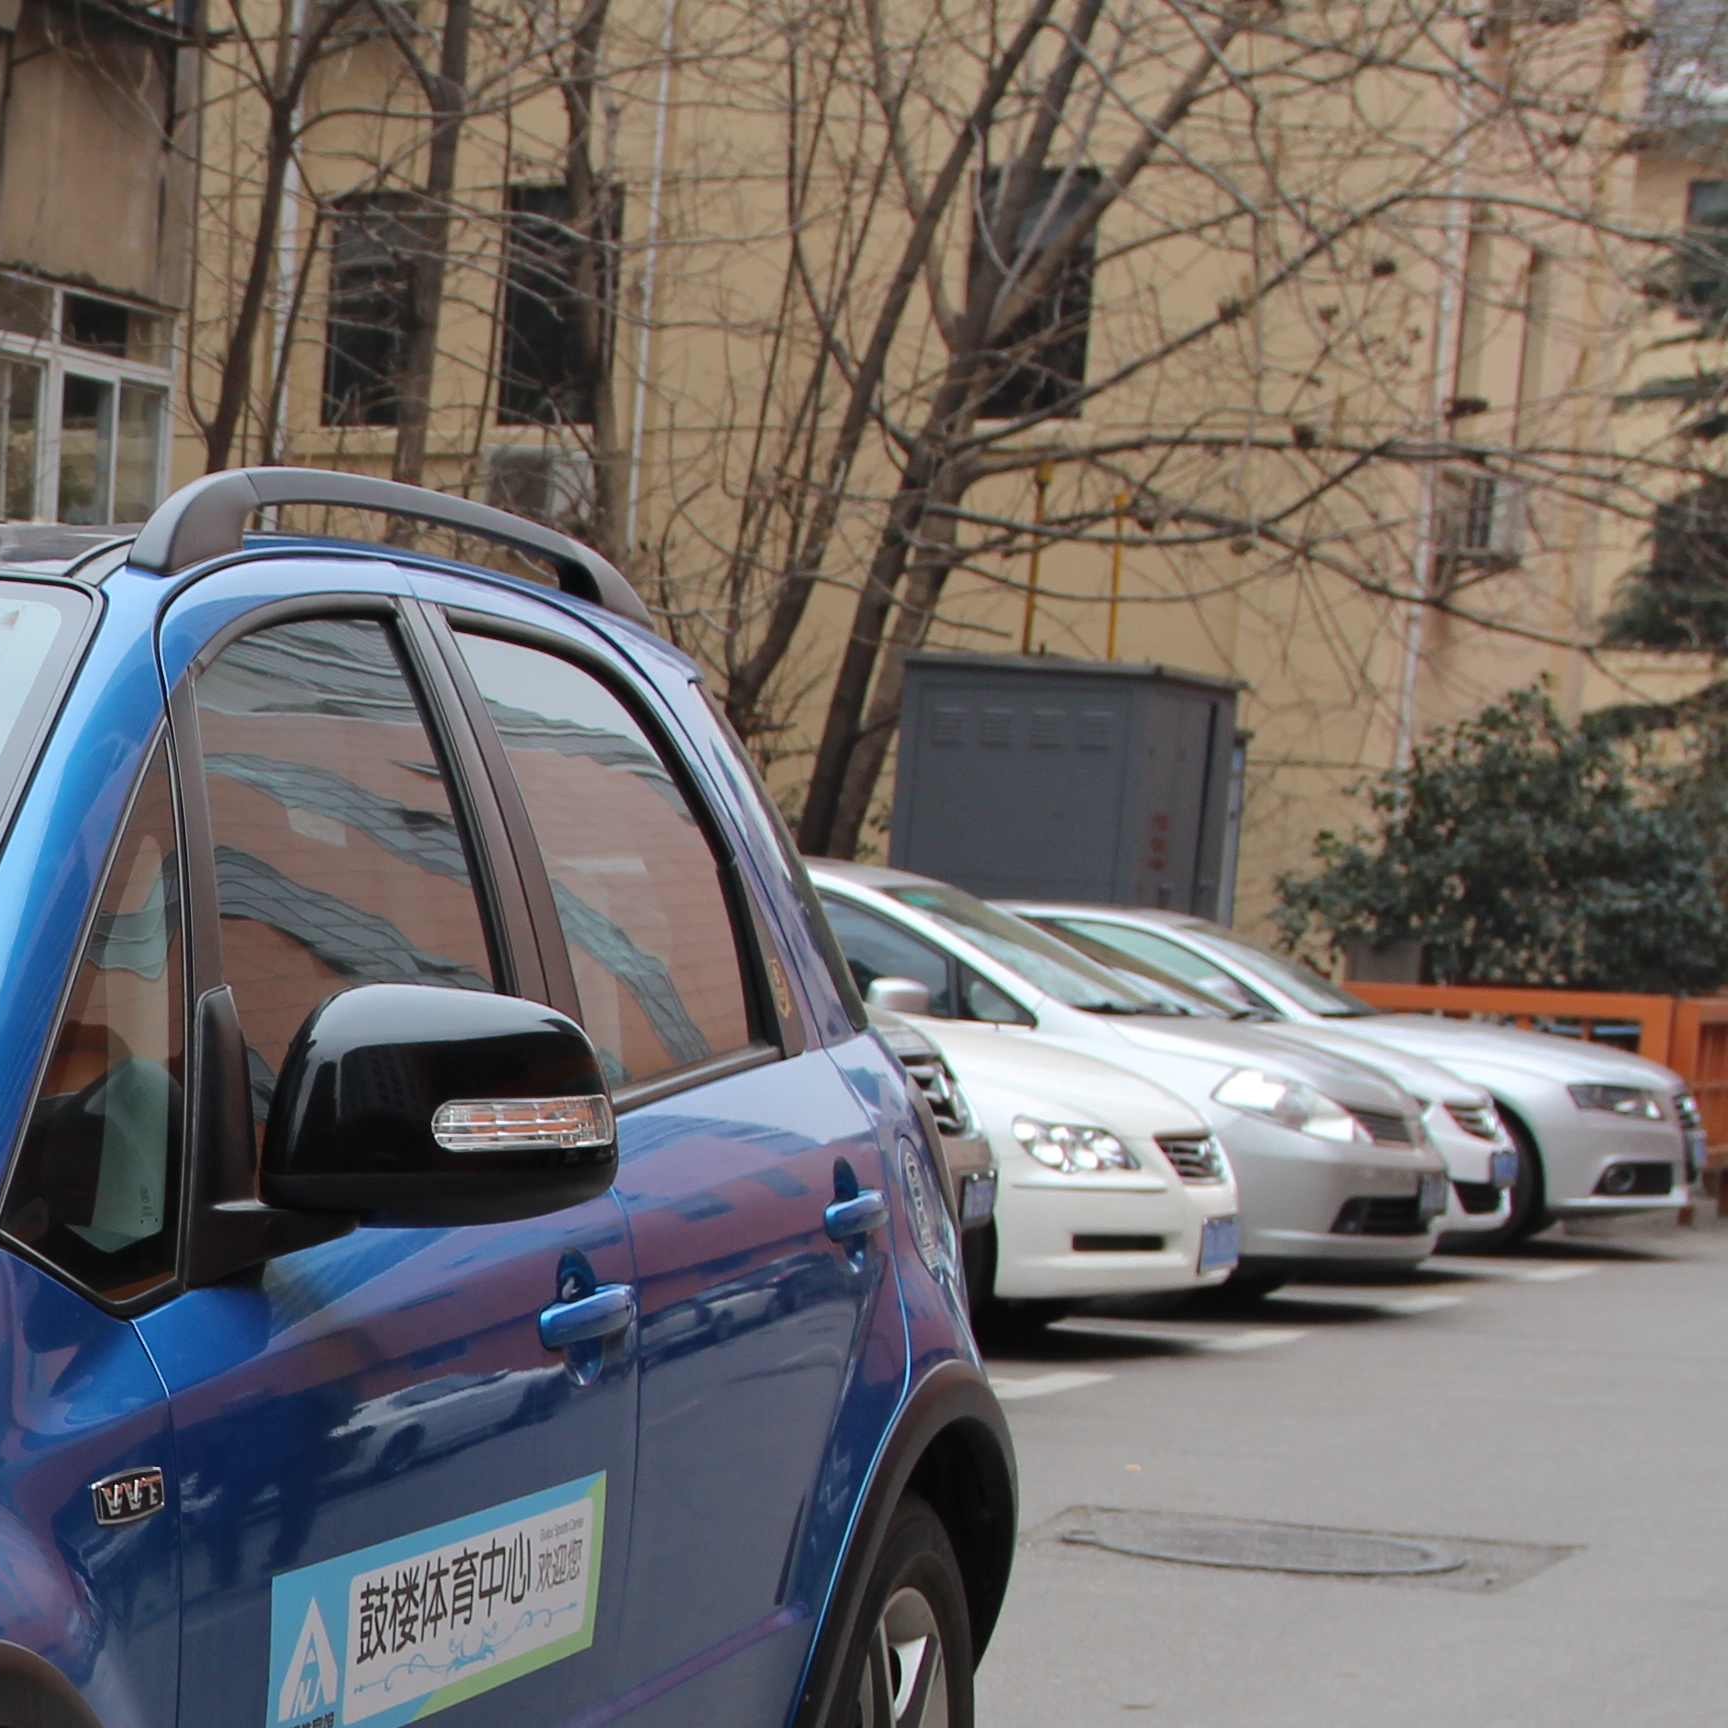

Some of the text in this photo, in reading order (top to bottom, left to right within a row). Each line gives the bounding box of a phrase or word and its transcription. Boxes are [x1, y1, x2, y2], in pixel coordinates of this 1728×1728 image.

[356, 1530, 532, 1665] 鼓楼体育中心
[535, 1538, 583, 1592] 欢迎您
